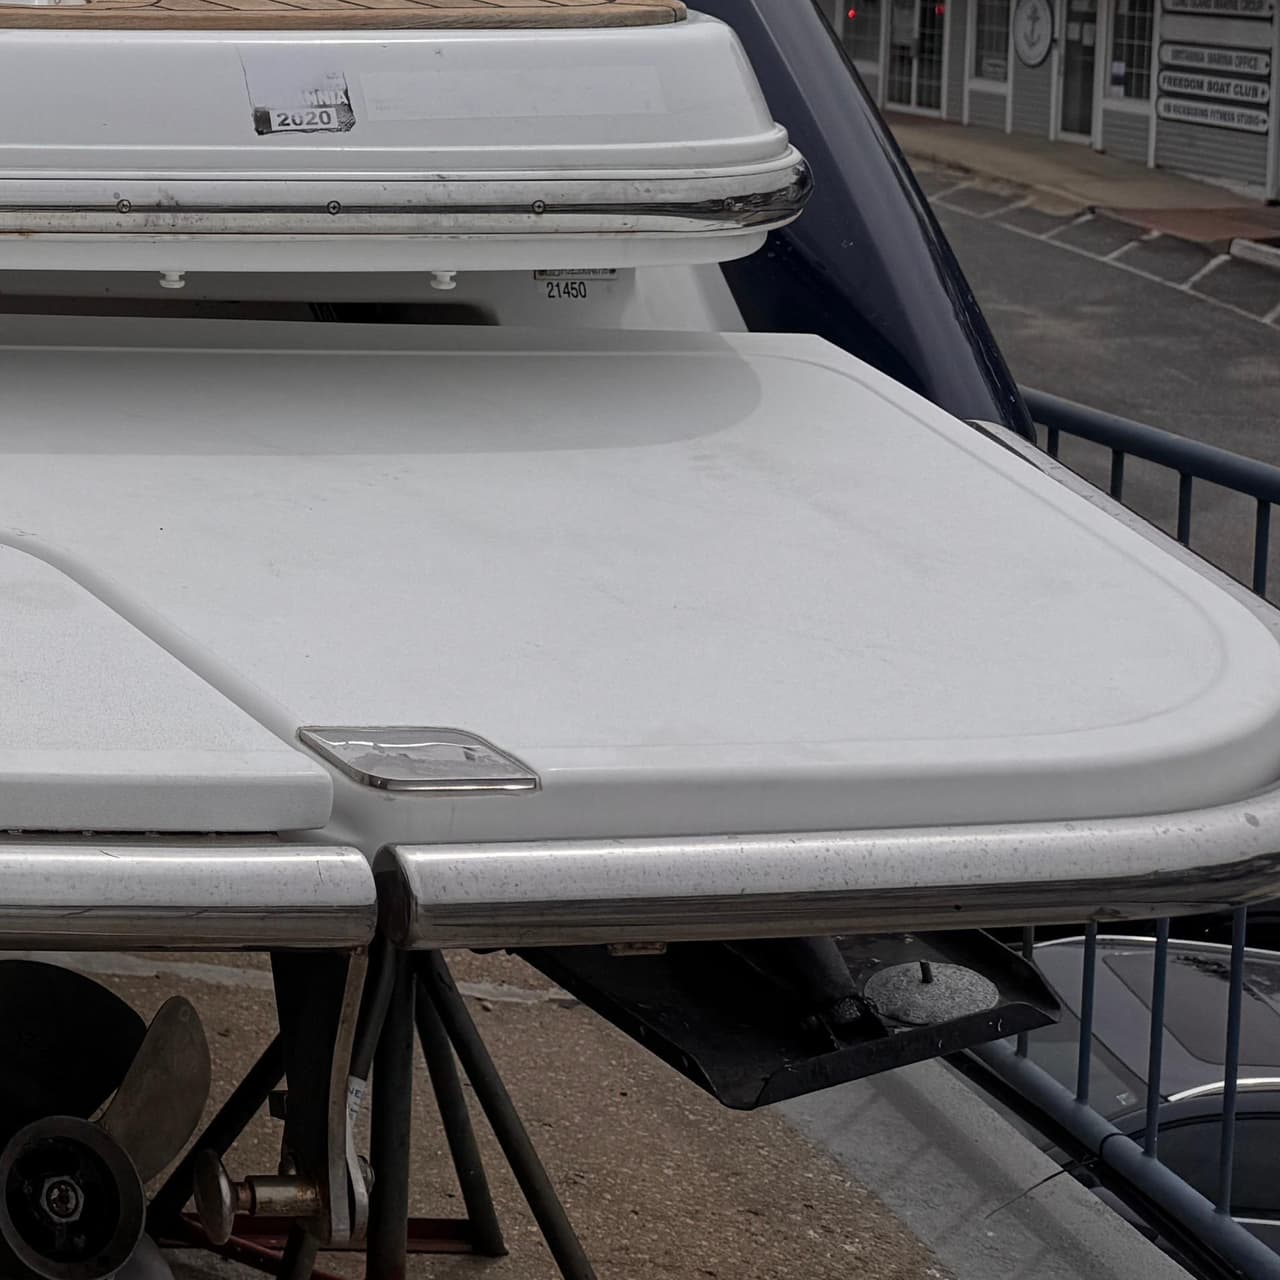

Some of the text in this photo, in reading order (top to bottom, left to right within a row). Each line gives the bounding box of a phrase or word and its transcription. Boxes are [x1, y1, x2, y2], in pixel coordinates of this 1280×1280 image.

[1162, 74, 1259, 98] FREEDOM BOAT CLUB
[276, 110, 332, 127] 2020
[546, 281, 587, 298] 21450
